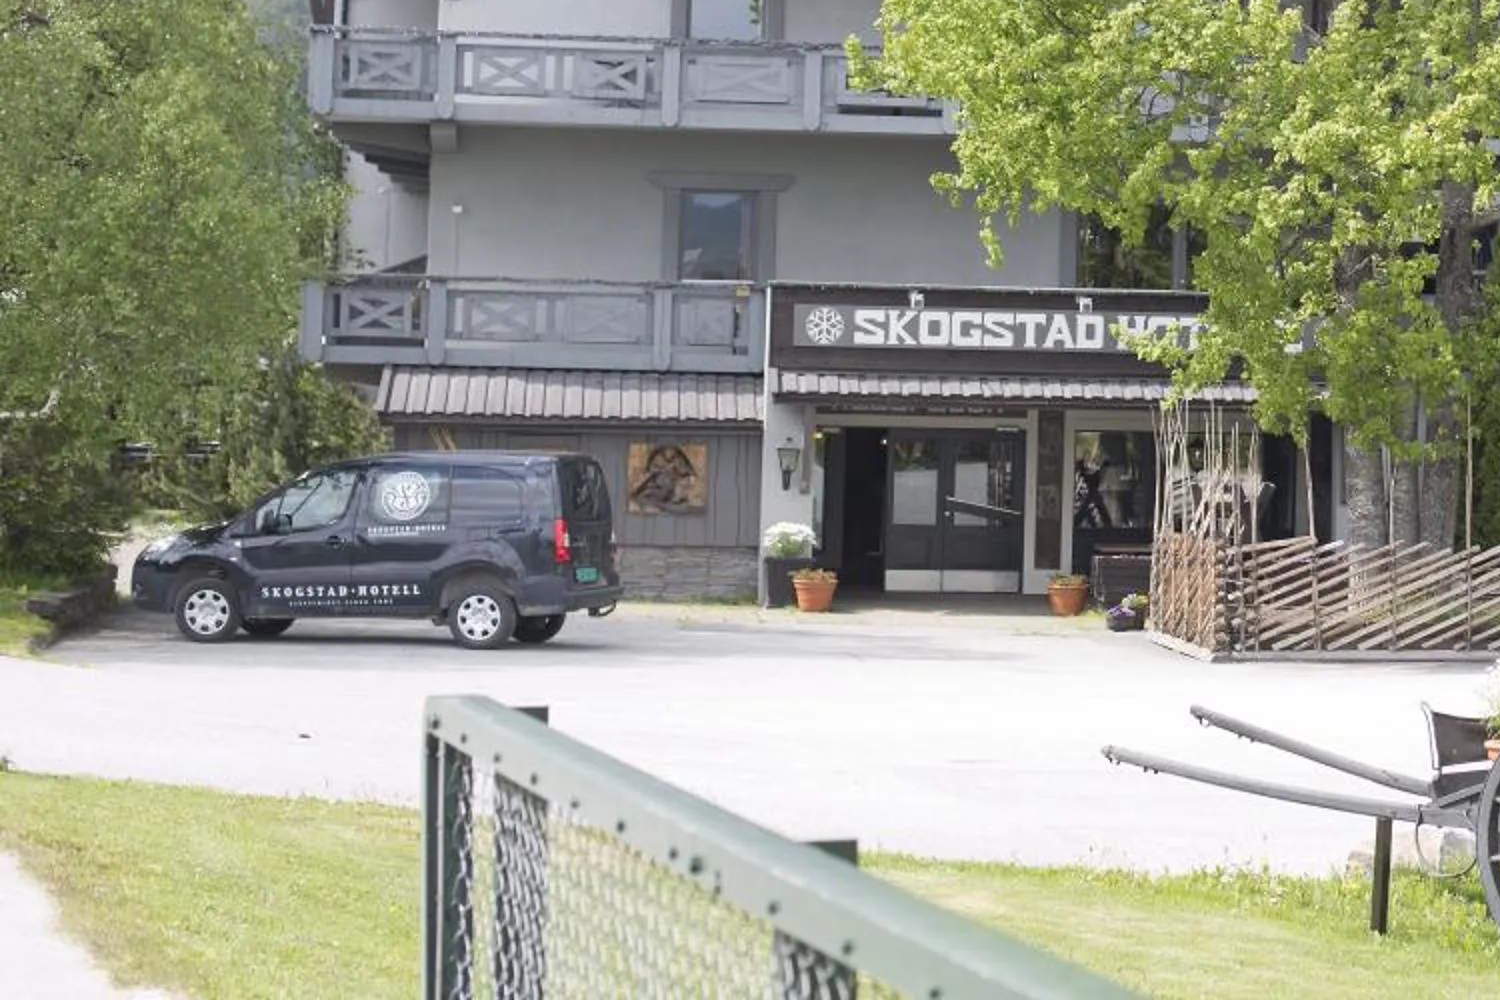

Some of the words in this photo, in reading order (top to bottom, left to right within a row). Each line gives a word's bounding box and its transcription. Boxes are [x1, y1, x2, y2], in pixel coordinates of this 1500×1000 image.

[853, 308, 1104, 350] SKOGSTAD
[261, 585, 348, 598] SKOGSTAD
[358, 584, 421, 596] HOTELL
